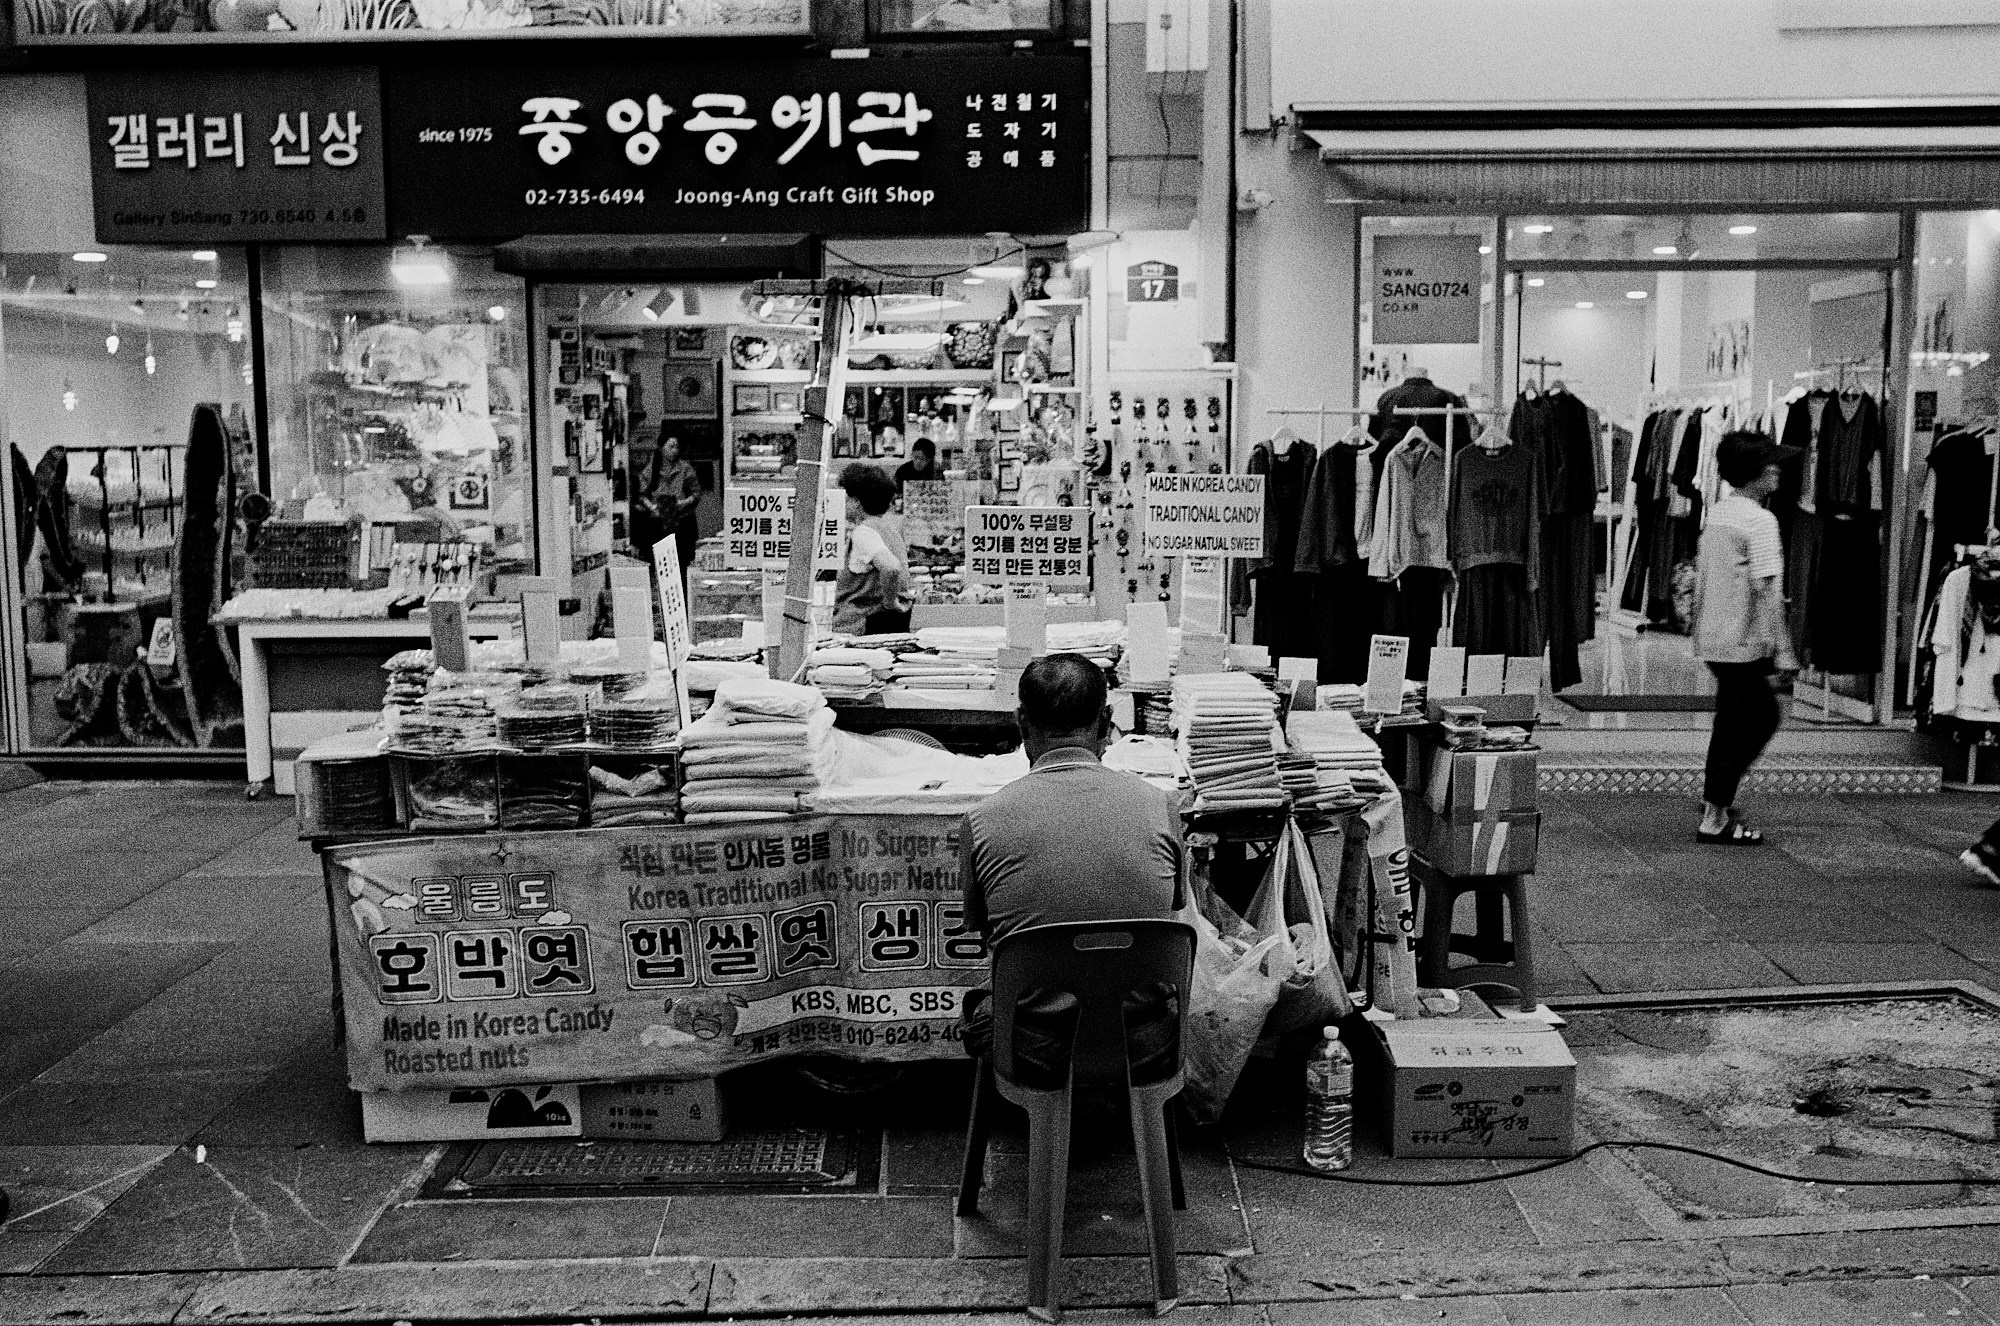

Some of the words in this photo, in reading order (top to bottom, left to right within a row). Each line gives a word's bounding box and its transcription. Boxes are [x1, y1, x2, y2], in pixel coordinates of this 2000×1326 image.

[418, 128, 455, 143] since
[458, 127, 493, 143] 1975
[518, 91, 933, 166] 중앙공예관
[965, 121, 1057, 139] 도자기
[107, 112, 245, 169] 갤러리
[269, 110, 363, 167] 신상
[965, 150, 1056, 168] 공예품
[524, 188, 645, 205] 02-735-6494
[675, 187, 779, 207] Joong-Ang
[786, 186, 834, 203] Craft
[841, 186, 879, 204] Gift
[885, 186, 935, 206] Shop
[112, 210, 165, 227] Gallery
[1141, 280, 1165, 299] 17
[1149, 476, 1178, 492] MADE
[1180, 477, 1190, 492] IN
[1192, 477, 1225, 493] KOREA
[1227, 477, 1261, 493] CANDY
[739, 495, 782, 512] 100%
[981, 513, 1025, 531] 100%
[1029, 514, 1073, 531] 무설탕
[1149, 505, 1221, 523] TRADITIONAL
[1223, 505, 1261, 523] CANDY
[730, 517, 773, 535] 엿기름
[730, 540, 758, 558] 직접
[763, 541, 791, 558] 만든
[971, 535, 1015, 553] 엿기름
[1020, 536, 1048, 553] 천연
[1053, 536, 1082, 554] 당분
[1148, 535, 1160, 550] NO
[1163, 535, 1193, 550] SUGAR
[1194, 536, 1229, 550] NATUAL
[1230, 536, 1261, 551] SWEET
[971, 558, 1000, 575] 직접
[1005, 558, 1034, 576] 만든
[1039, 558, 1082, 576] 전통엿
[723, 835, 785, 872] 인사동
[790, 831, 831, 865] 명물
[841, 829, 870, 858] No
[628, 884, 690, 911] Korea
[693, 870, 807, 907] Traditional
[811, 865, 838, 892] No
[844, 866, 903, 898] Sugar
[421, 879, 550, 915] 울릉도
[628, 907, 831, 981] 햅쌀엿
[376, 933, 582, 994] 호박엿
[791, 990, 840, 1014] KBS,
[846, 993, 898, 1016] MBC,
[908, 991, 955, 1012] SBS
[383, 1015, 441, 1042] Made
[447, 1013, 468, 1039] in
[473, 1011, 539, 1038] Korea
[544, 1004, 614, 1033] Candy
[384, 1045, 473, 1074] Roasted
[479, 1043, 530, 1070] nuts
